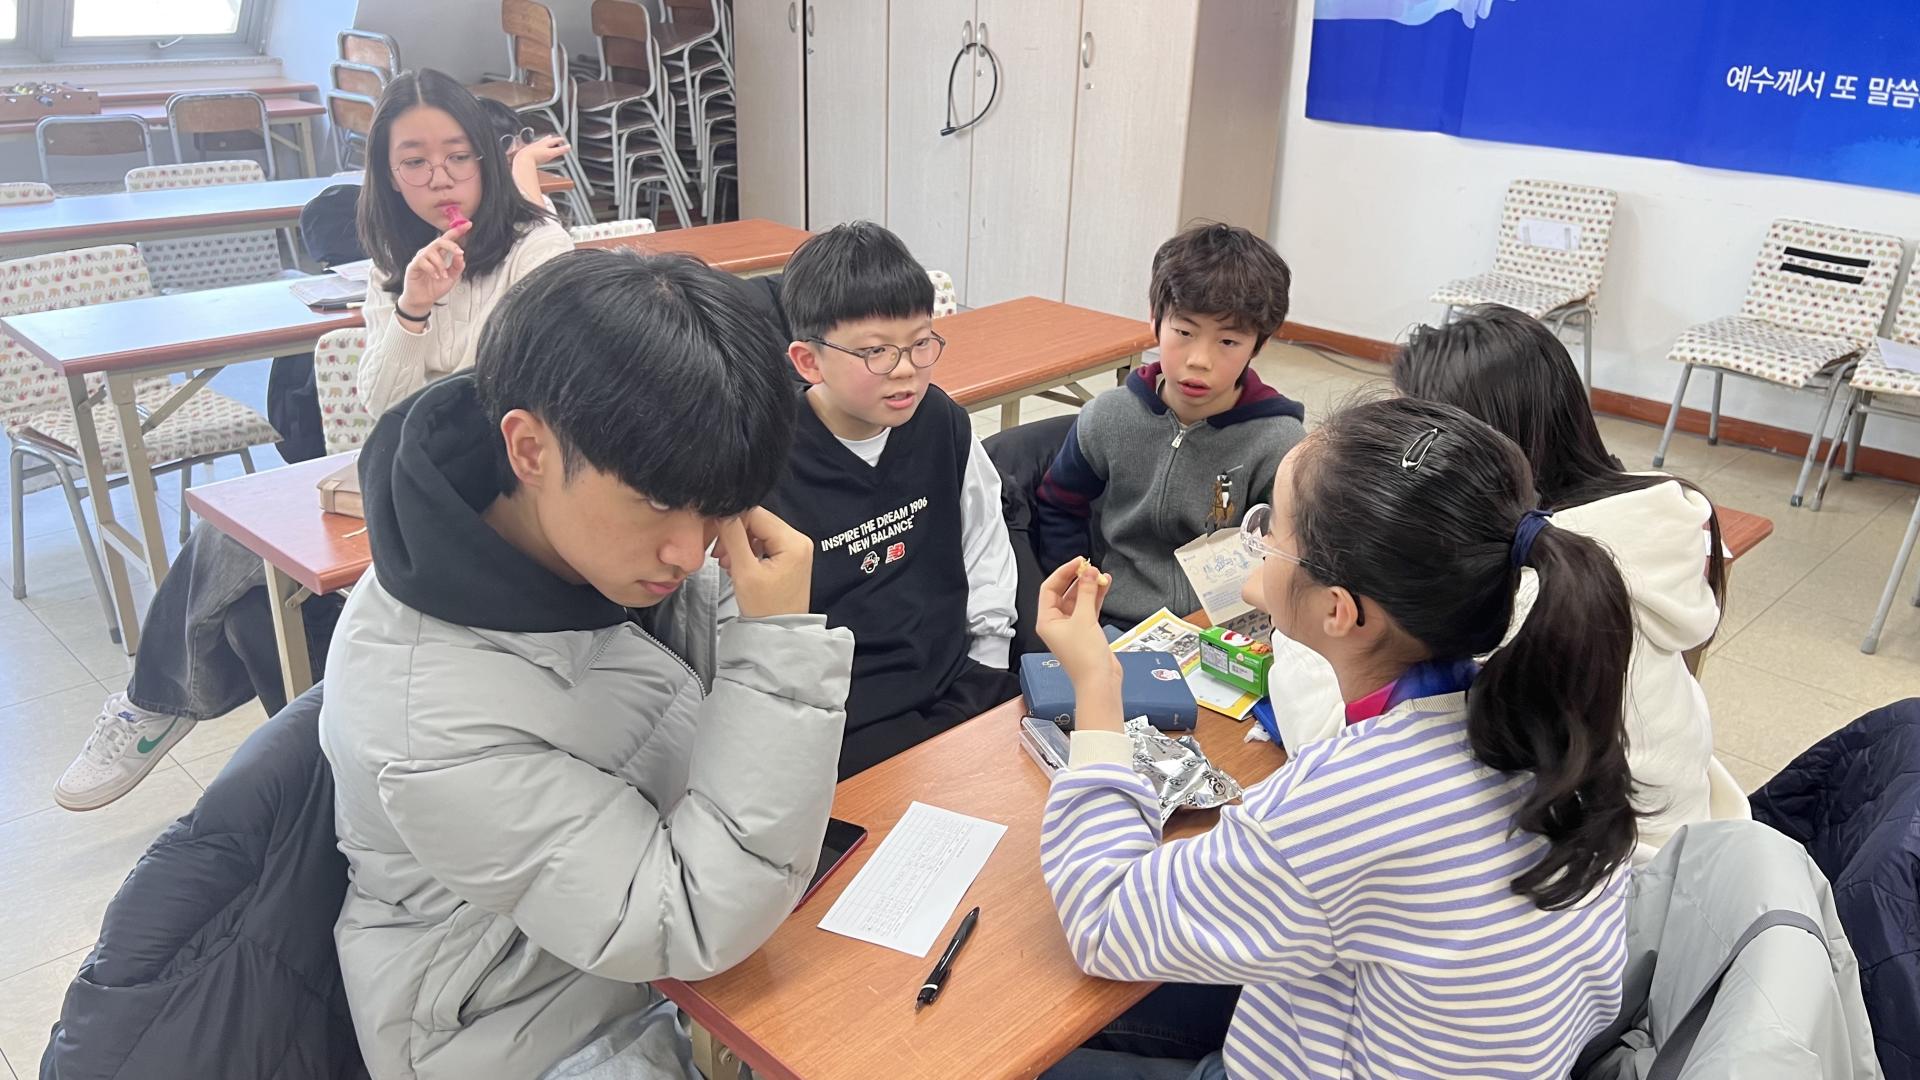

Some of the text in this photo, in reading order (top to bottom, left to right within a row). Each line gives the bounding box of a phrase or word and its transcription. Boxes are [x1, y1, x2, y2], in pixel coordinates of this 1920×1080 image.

[1726, 65, 1920, 109] 예수께서 또 말씀
[821, 496, 928, 552] INSPIRE THE DREAM 1906
[848, 516, 914, 556] NEW BALANCE
